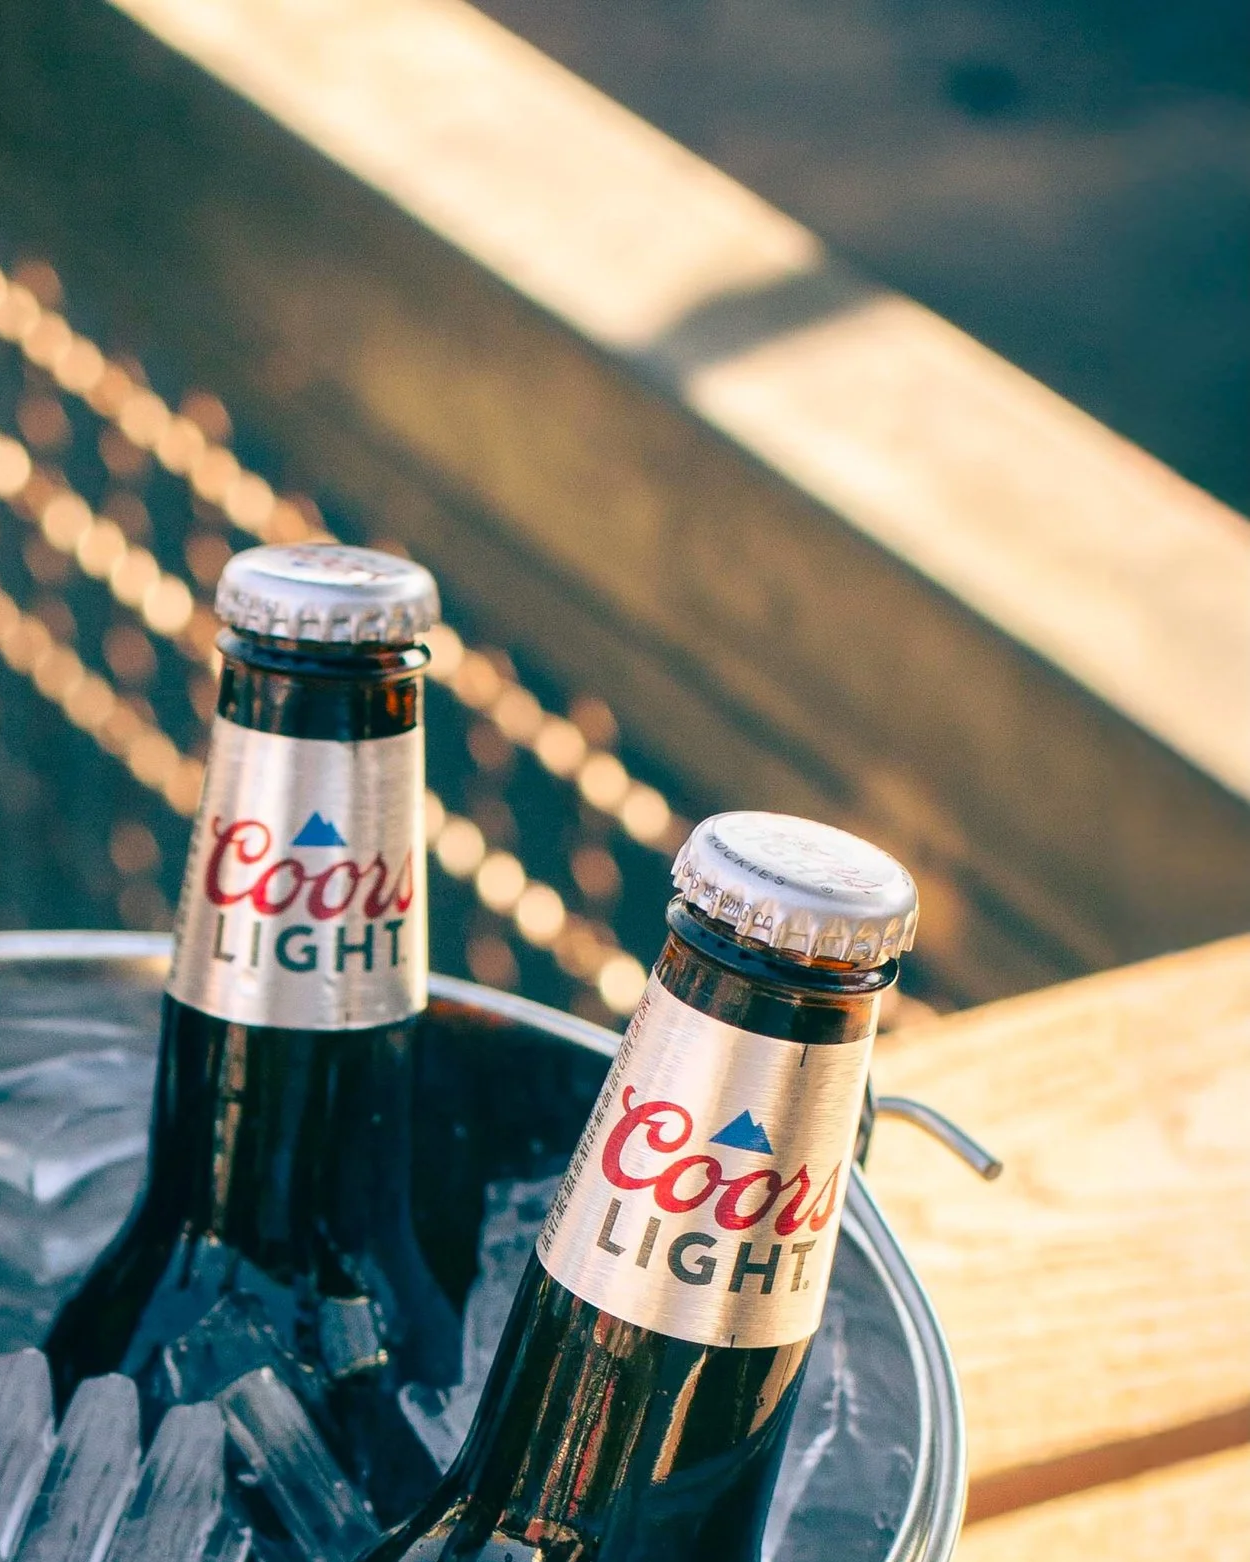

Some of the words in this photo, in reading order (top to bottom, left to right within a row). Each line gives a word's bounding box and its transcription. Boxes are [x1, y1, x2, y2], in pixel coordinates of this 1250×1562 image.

[205, 816, 414, 921] Coors
[214, 911, 406, 973] LIGHT
[601, 1084, 843, 1237] Coors
[596, 1197, 817, 1295] LIGHT
